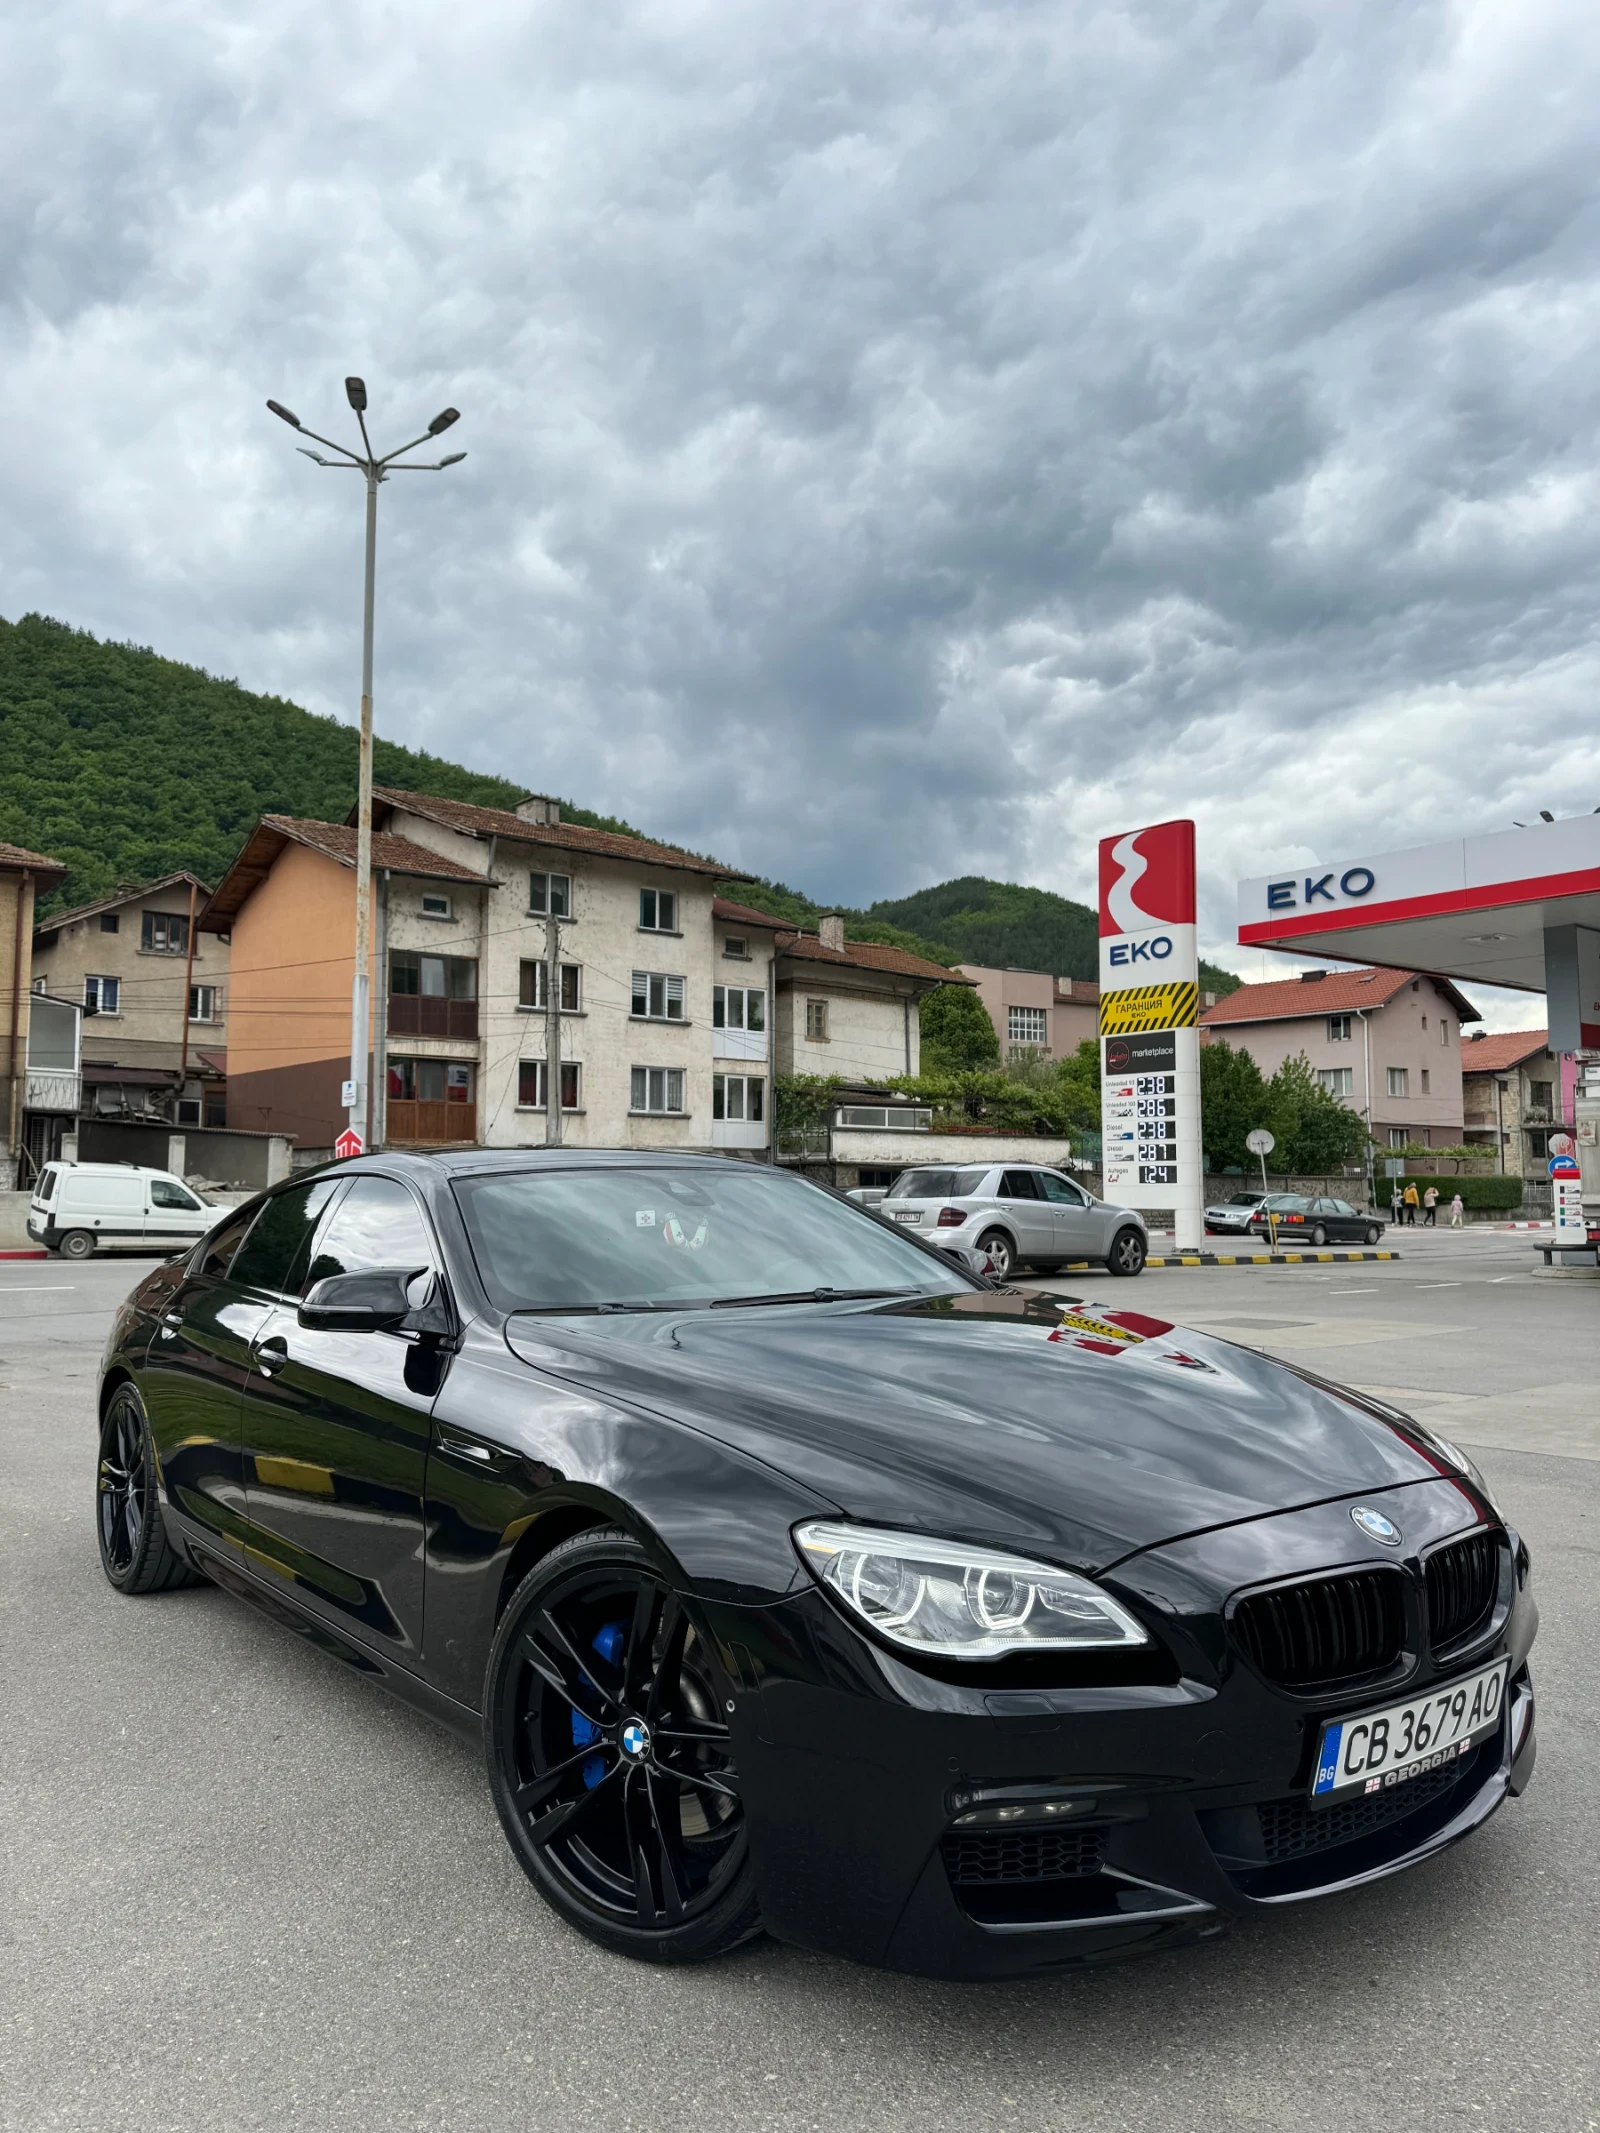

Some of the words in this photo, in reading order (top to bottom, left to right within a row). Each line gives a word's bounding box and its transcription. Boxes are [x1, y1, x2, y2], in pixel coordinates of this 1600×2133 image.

[1268, 867, 1375, 909] EKO
[1110, 936, 1173, 966] EKO
[1116, 1000, 1162, 1014] ГАРАНЦИЯ
[1132, 1047, 1174, 1058] marketplace
[1343, 1718, 1390, 1775] CB
[1393, 1689, 1467, 1759] 3679
[1466, 1672, 1500, 1729] AO
[1318, 1765, 1335, 1783] BG
[1384, 1746, 1456, 1787] GEORGIA
